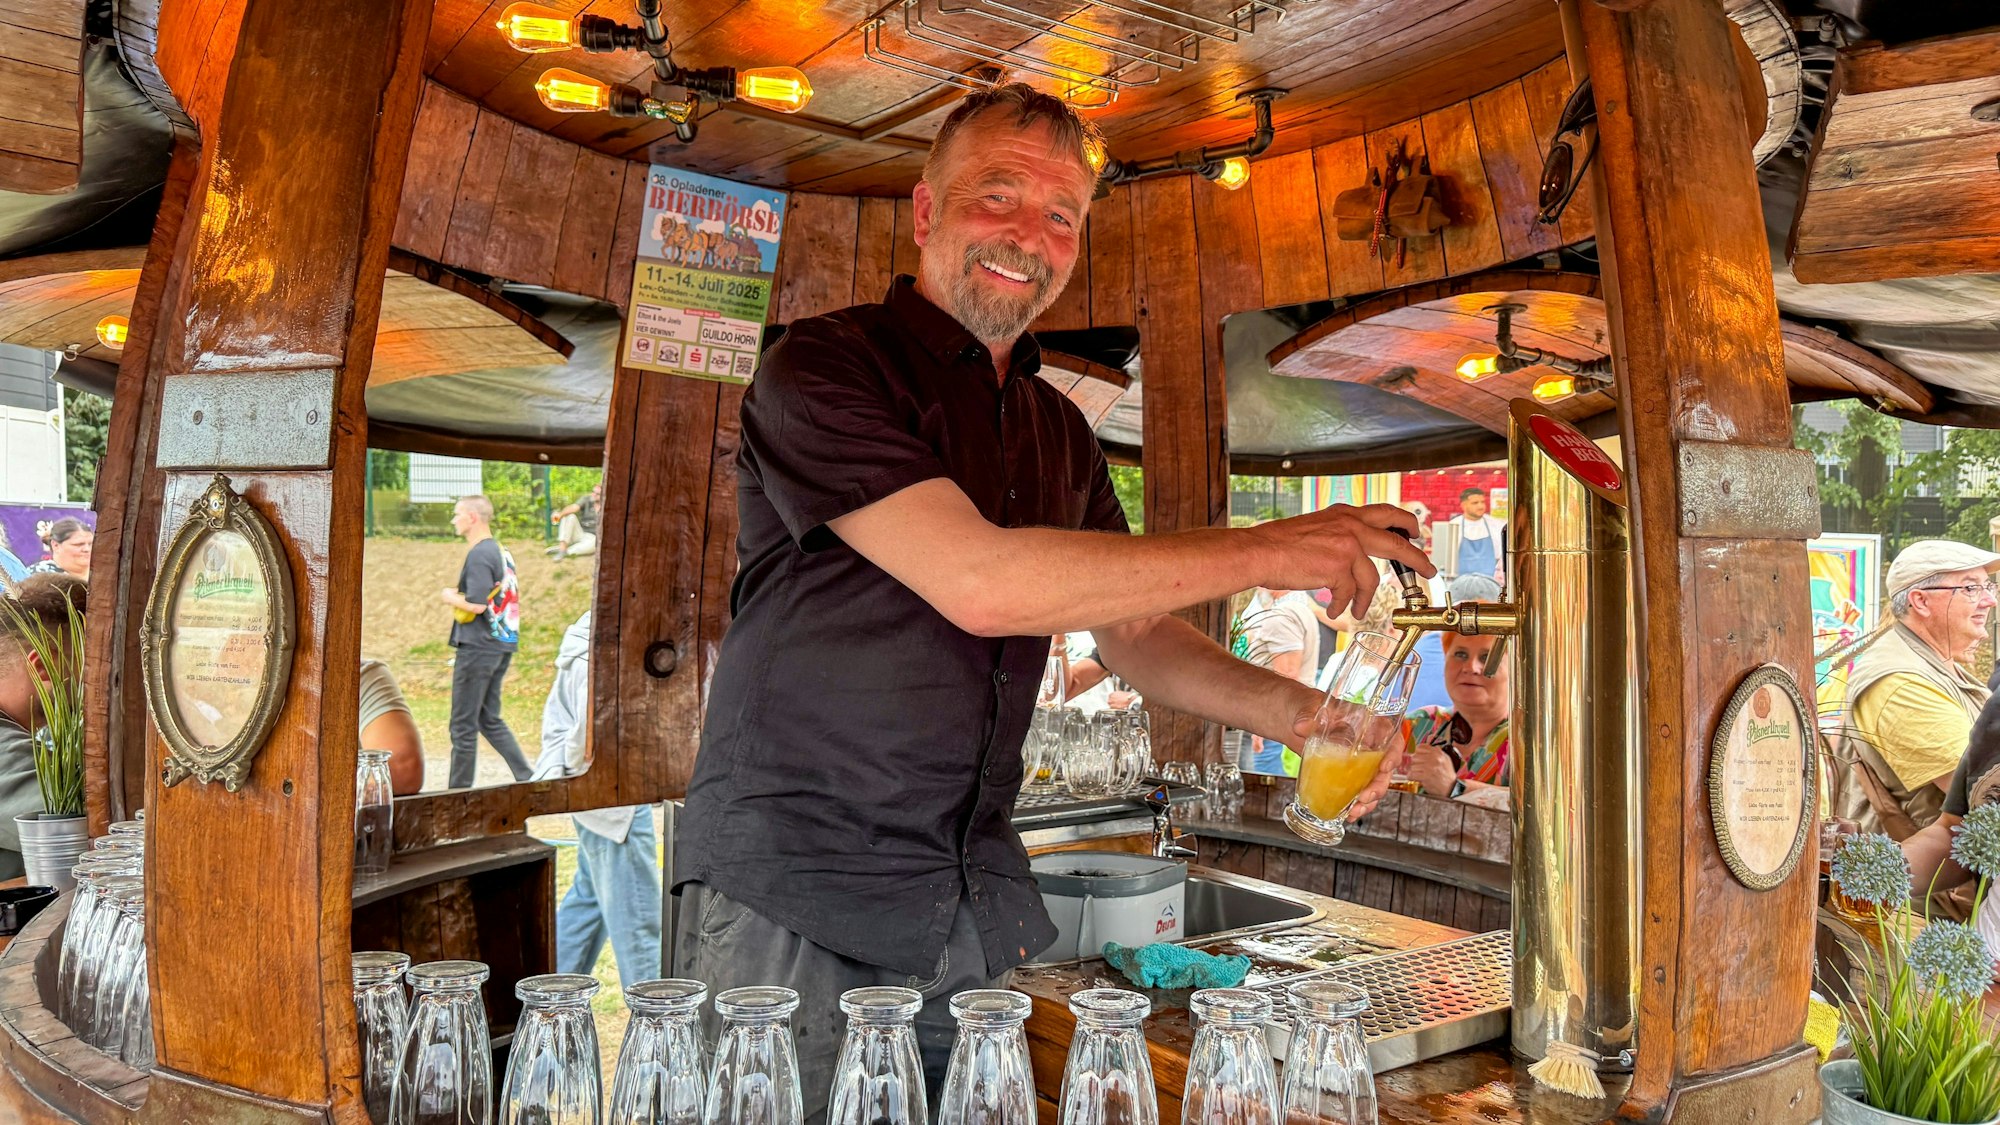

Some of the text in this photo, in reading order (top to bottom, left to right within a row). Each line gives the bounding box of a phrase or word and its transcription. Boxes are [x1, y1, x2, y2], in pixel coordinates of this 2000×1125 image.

[670, 177, 727, 199] Opladener
[649, 185, 780, 235] BIERBÖRSE
[647, 265, 761, 300] 11.-14. Juli 2025
[635, 325, 649, 333] VIER
[702, 327, 733, 343] GUILDO
[733, 332, 758, 347] HORN
[194, 572, 254, 601] Pilsner Urquell
[1747, 718, 1790, 748] Pilsner Urquell
